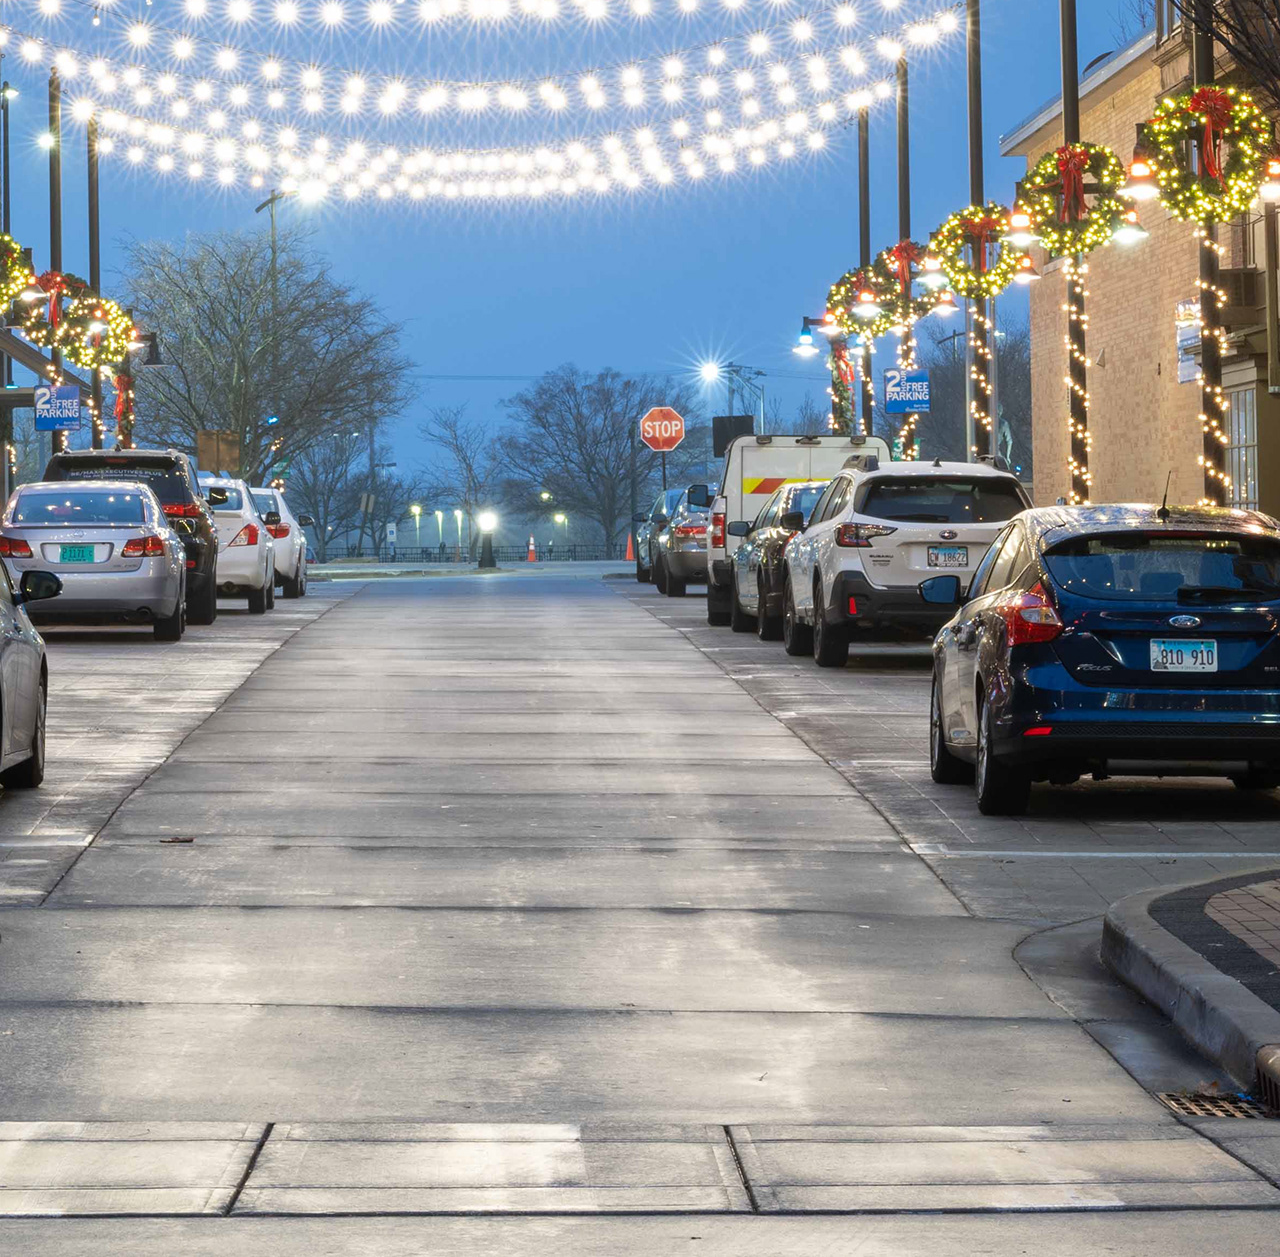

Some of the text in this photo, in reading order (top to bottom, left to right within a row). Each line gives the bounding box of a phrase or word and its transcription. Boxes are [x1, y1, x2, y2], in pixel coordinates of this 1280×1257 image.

[885, 370, 900, 391] 2
[907, 382, 929, 391] FREE
[35, 387, 50, 409] 2
[57, 400, 79, 409] FREE
[886, 392, 929, 401] PARKING
[36, 409, 79, 418] PARKING
[644, 421, 681, 438] STOP
[1161, 649, 1214, 665] 810 910
